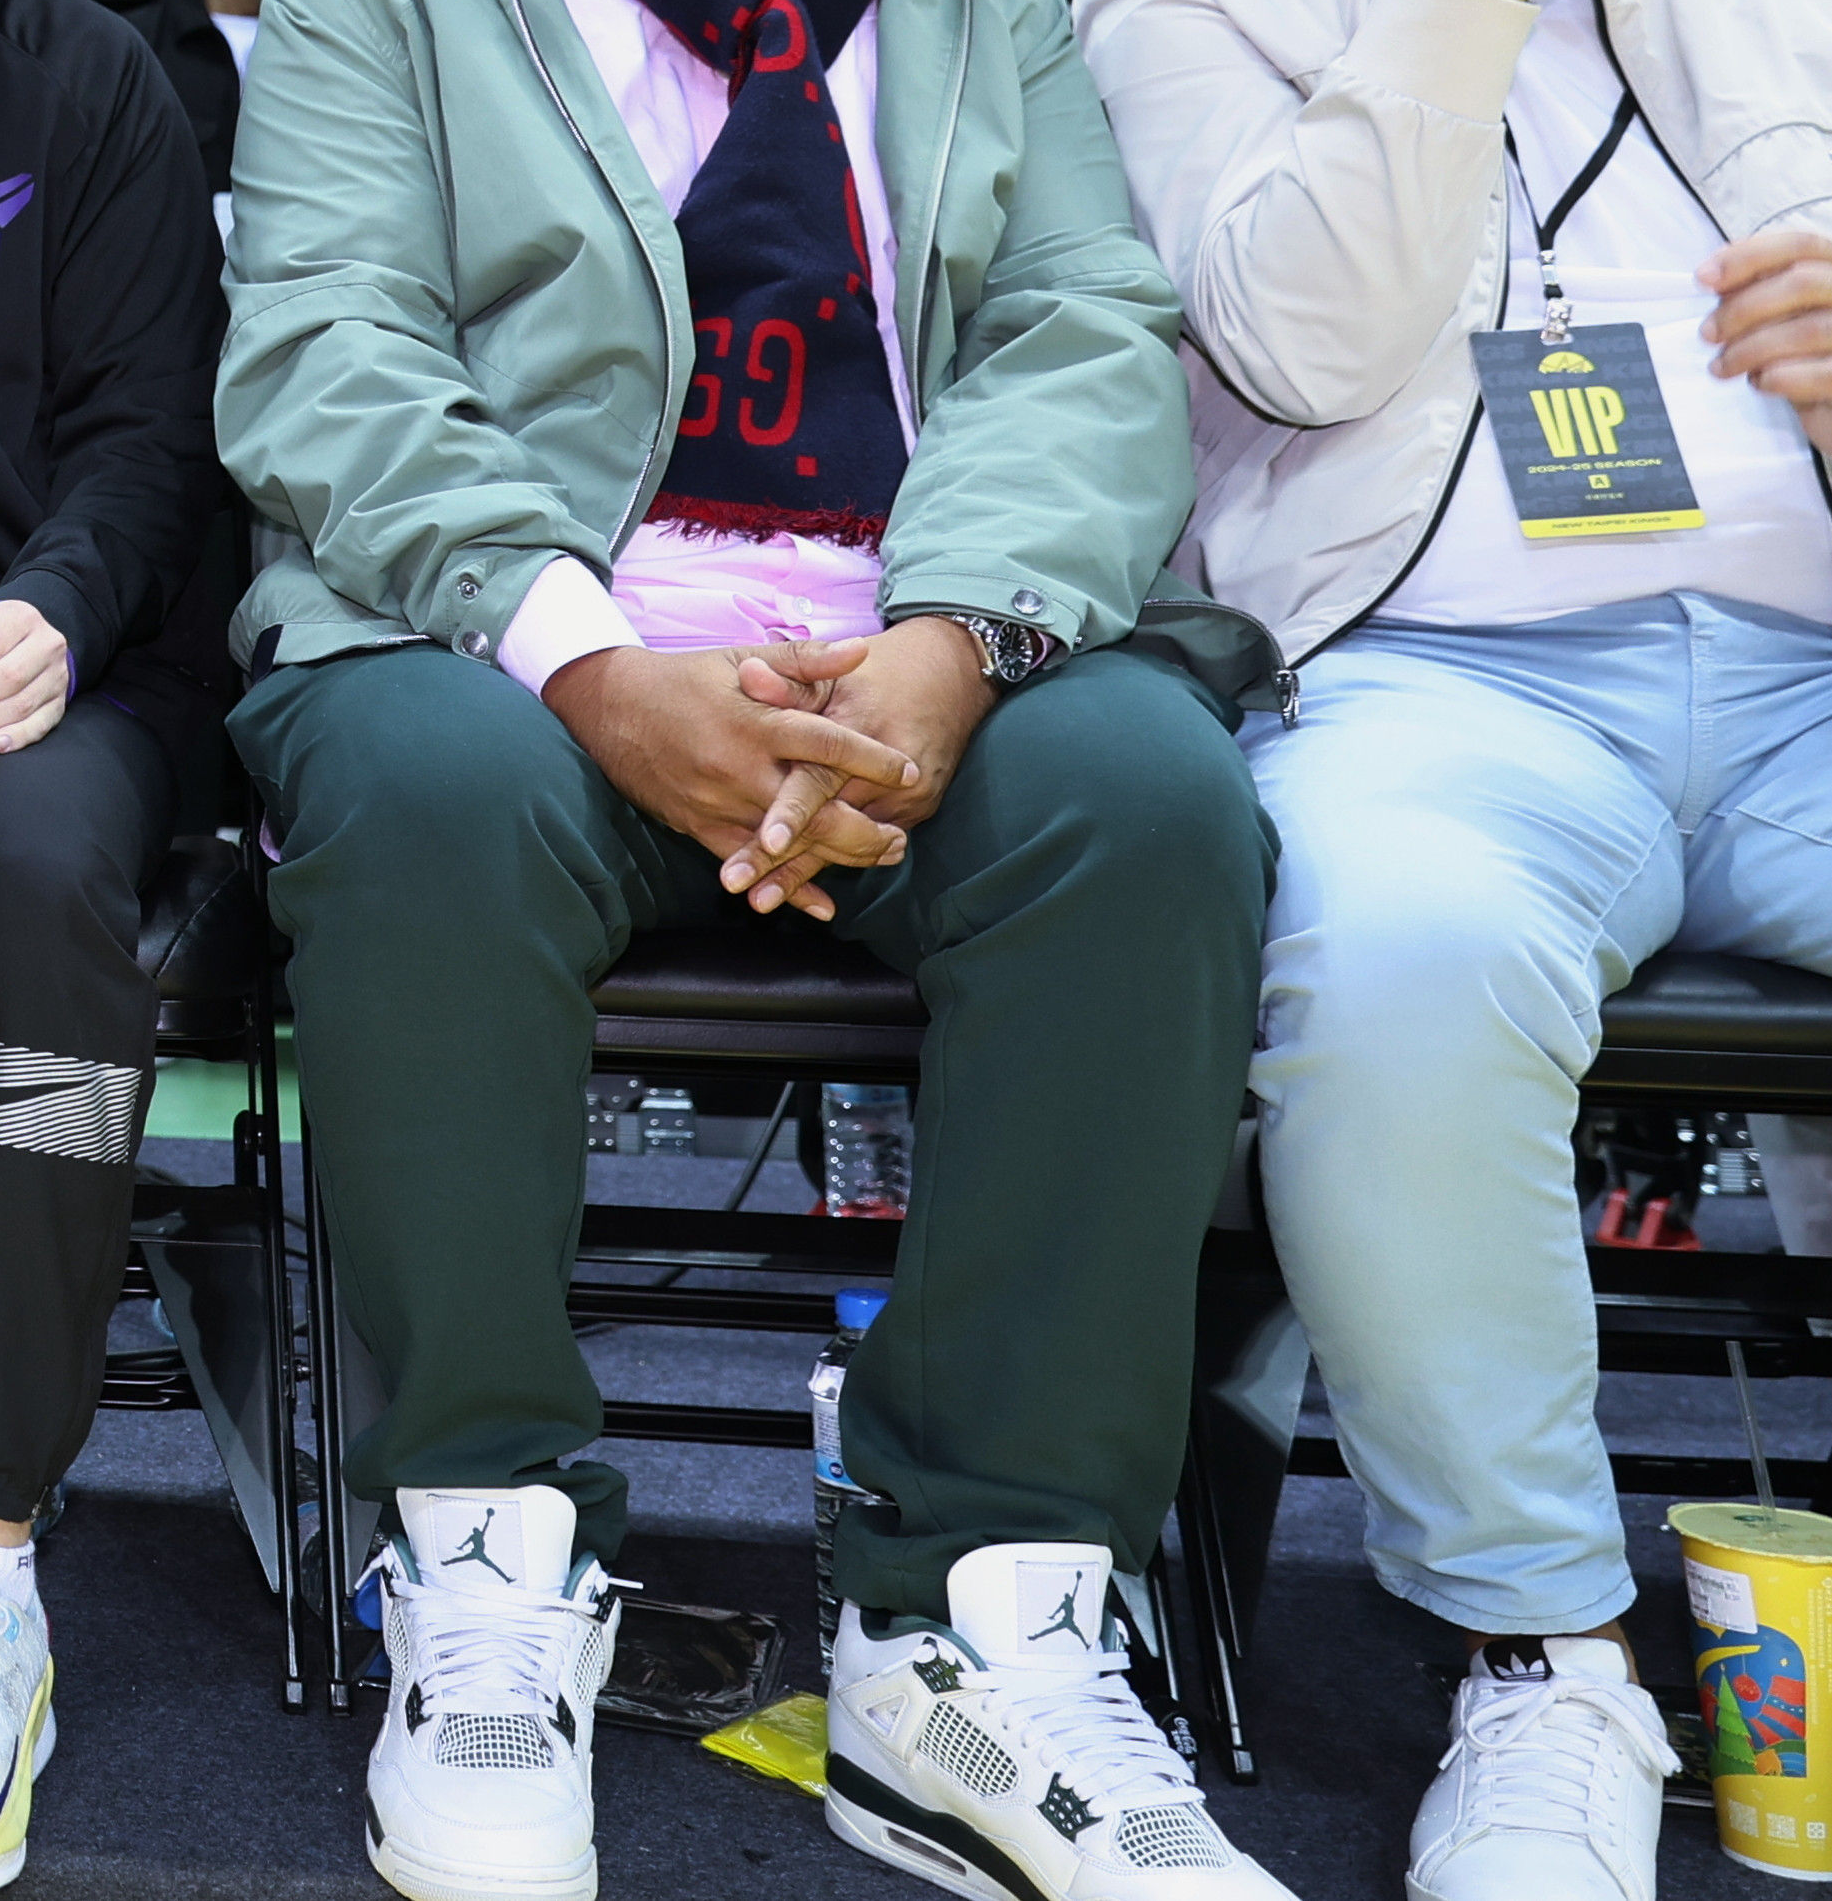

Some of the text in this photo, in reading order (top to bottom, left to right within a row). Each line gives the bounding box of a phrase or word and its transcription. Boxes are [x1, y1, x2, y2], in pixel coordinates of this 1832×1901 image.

[1528, 385, 1625, 458] VIP
[1527, 458, 1663, 474] 2024-25 SEASON
